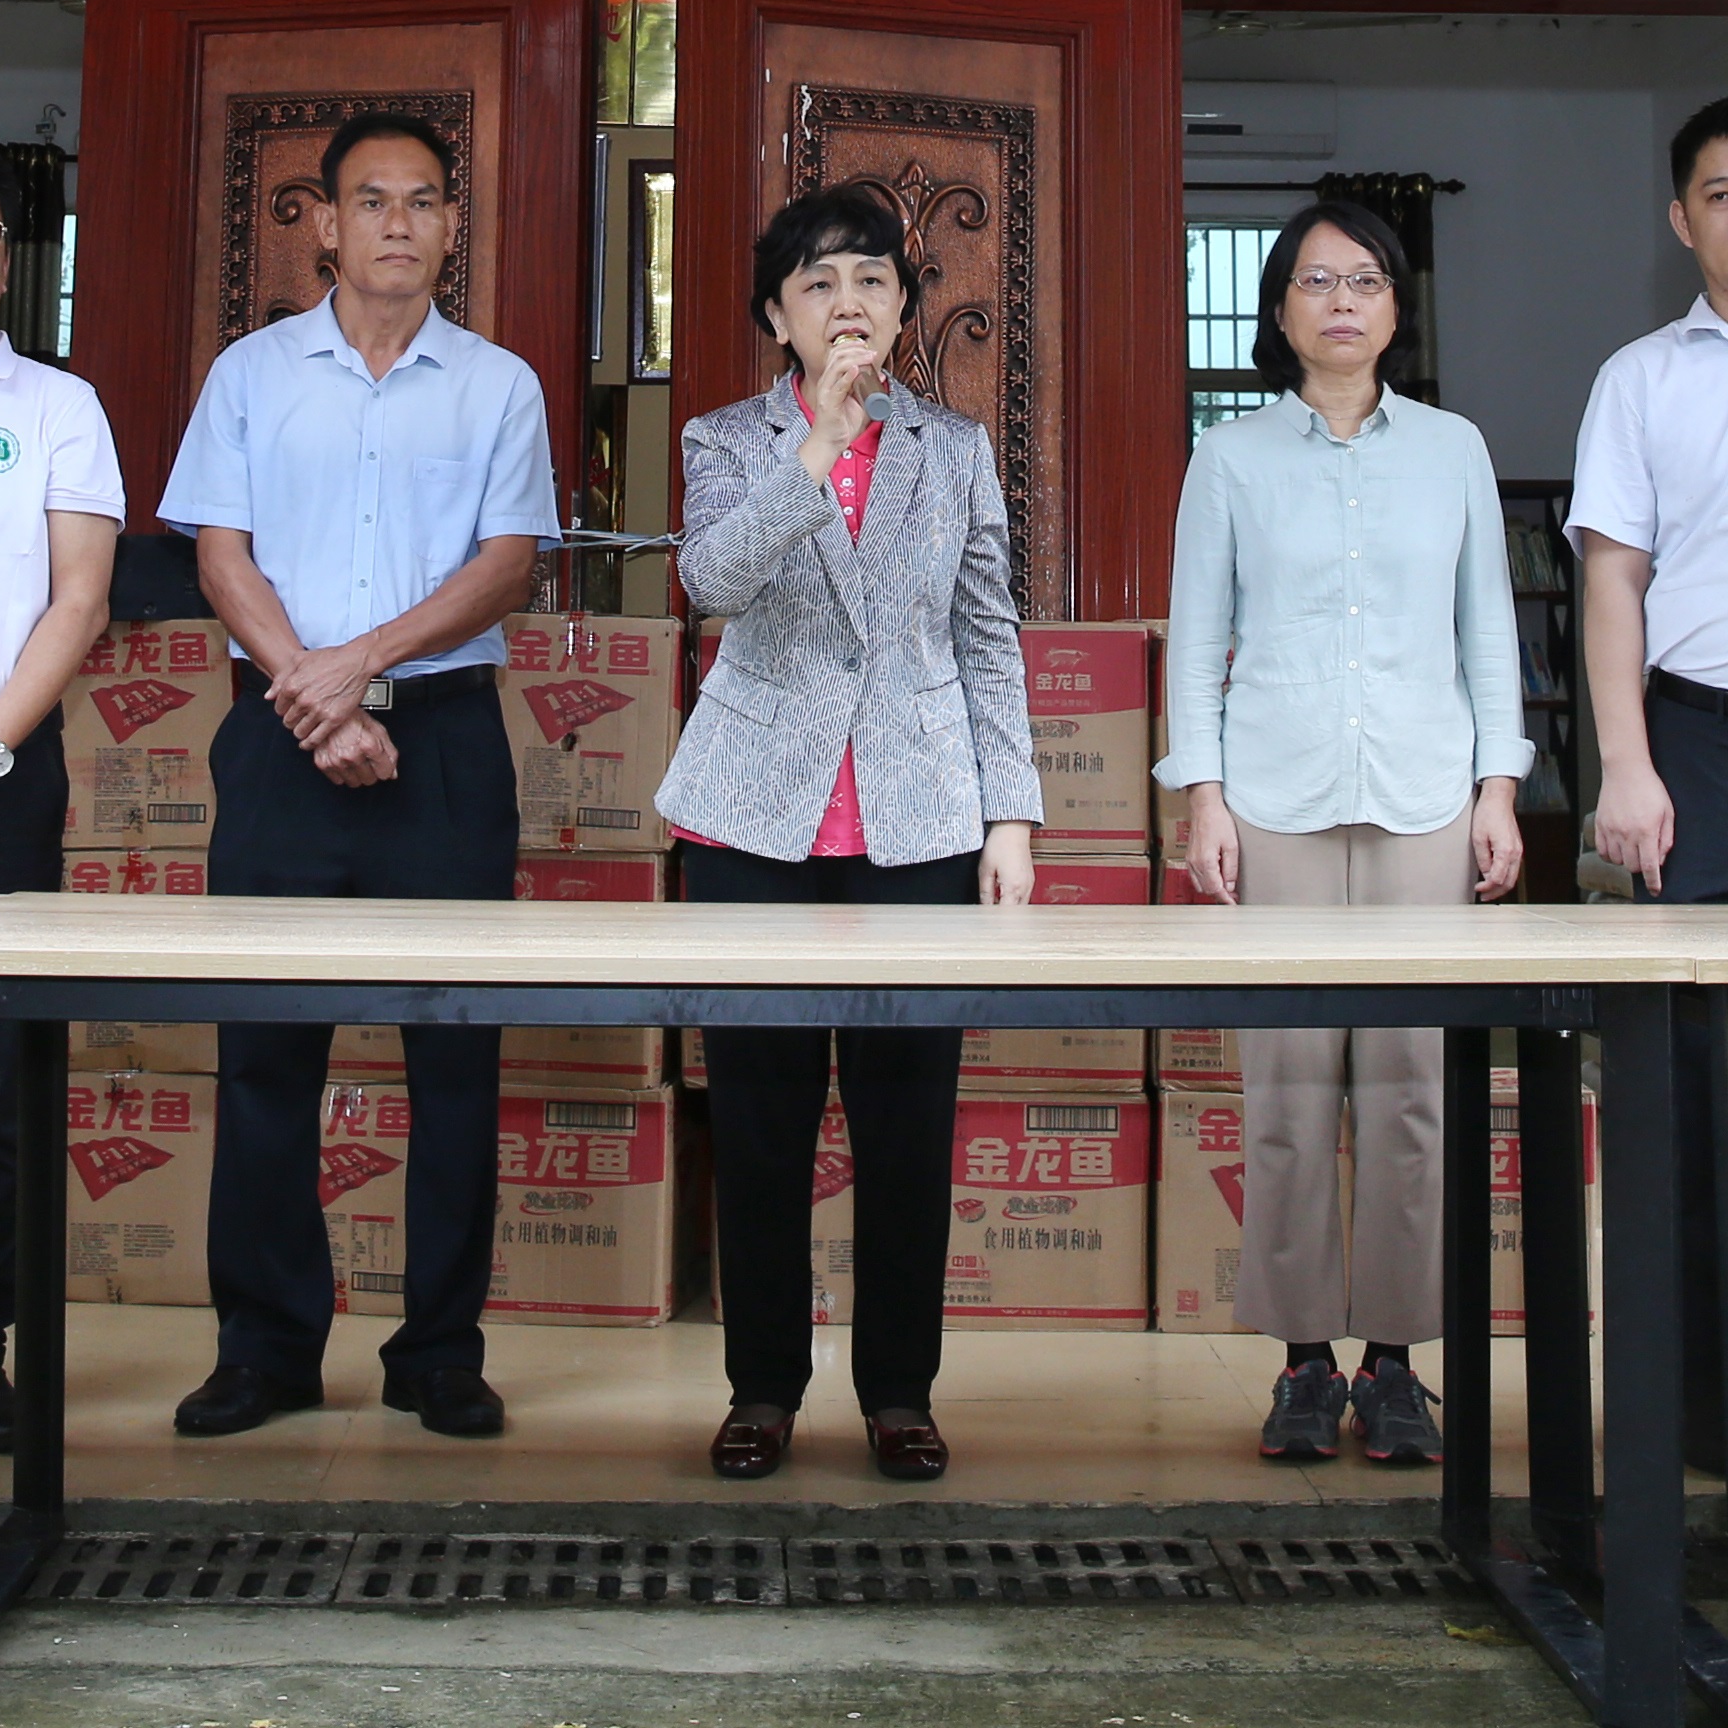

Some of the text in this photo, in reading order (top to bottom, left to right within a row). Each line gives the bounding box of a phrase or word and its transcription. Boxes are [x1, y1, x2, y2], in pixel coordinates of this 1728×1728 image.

[78, 631, 209, 674] 金龙鱼
[508, 629, 650, 675] 金龙鱼
[1035, 672, 1093, 691] 金龙鱼
[1031, 751, 1105, 774] 物调和油
[67, 1086, 191, 1133] 金龙鱼
[1198, 1108, 1242, 1152] 金
[498, 1132, 630, 1182] 金龙鱼
[965, 1137, 1114, 1185] 金龙鱼
[501, 1220, 618, 1248] 食用植物调和油
[983, 1226, 1102, 1251] 食用植物调和油
